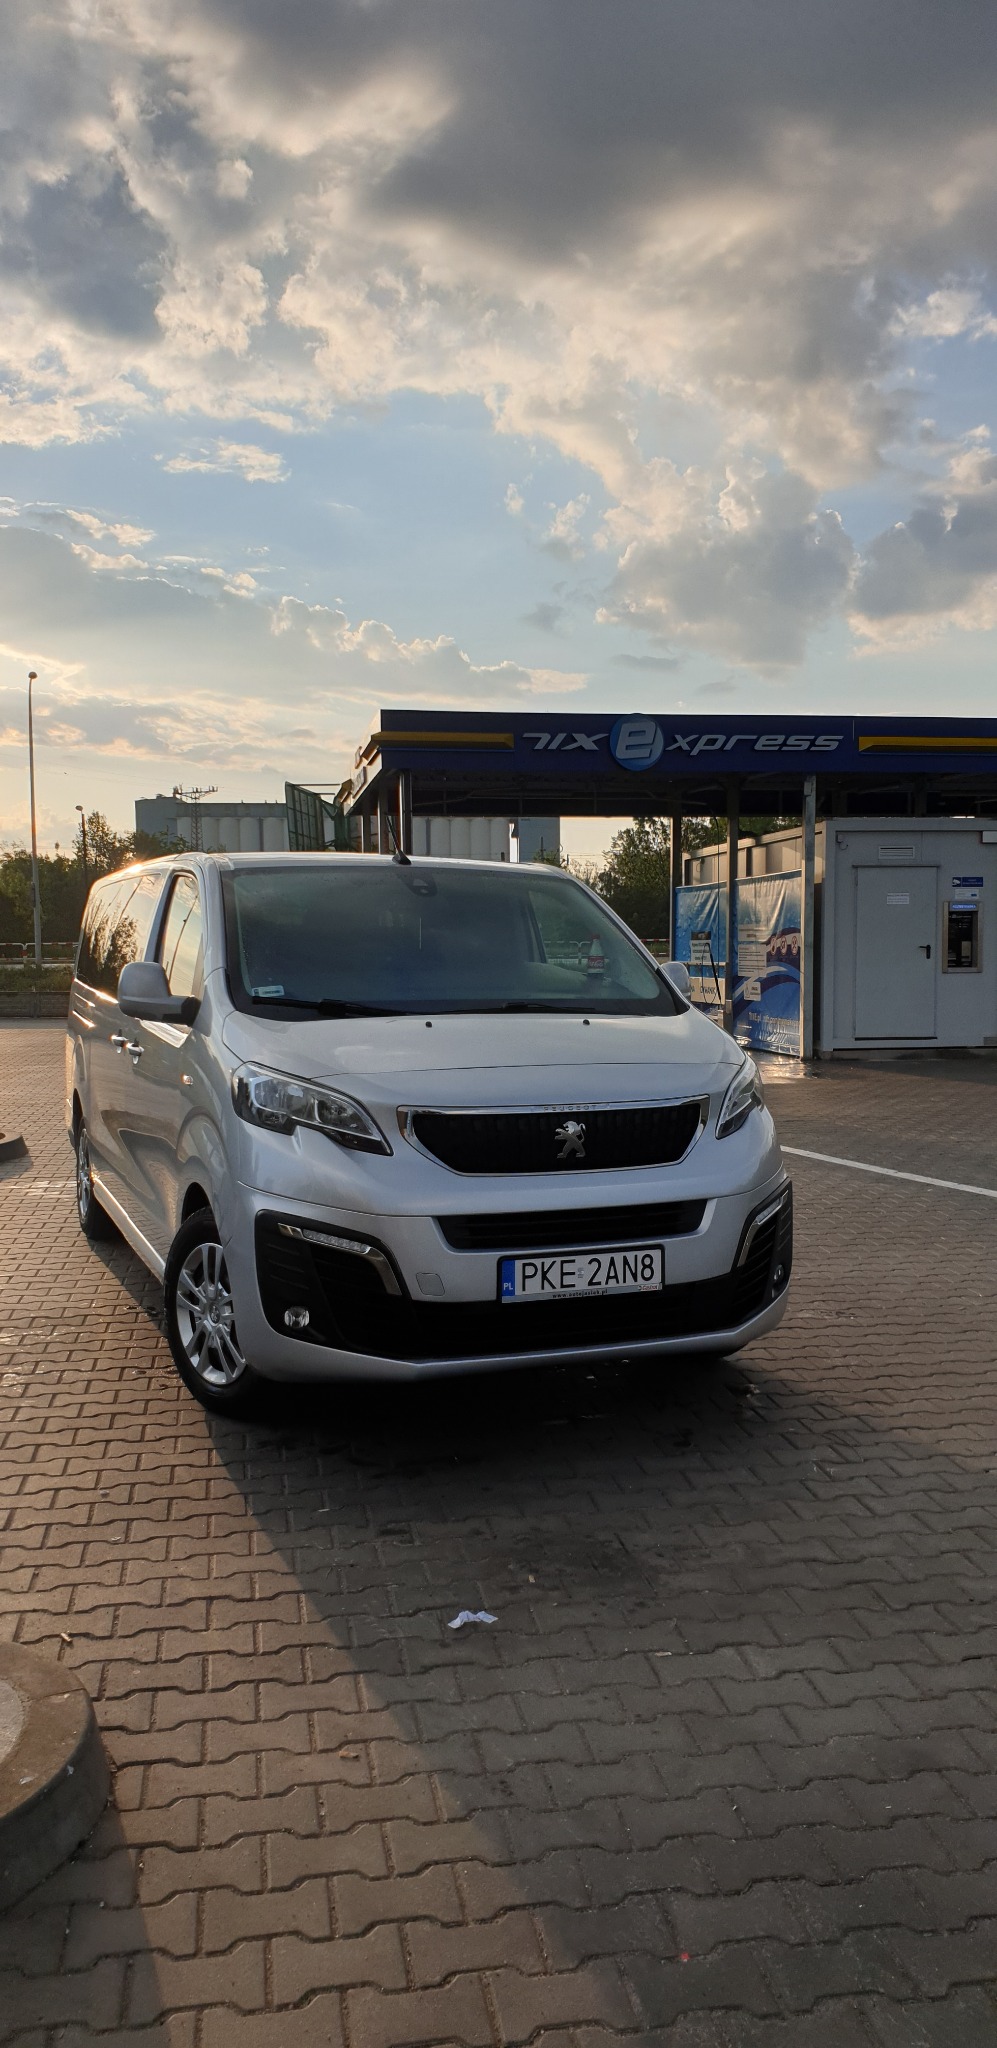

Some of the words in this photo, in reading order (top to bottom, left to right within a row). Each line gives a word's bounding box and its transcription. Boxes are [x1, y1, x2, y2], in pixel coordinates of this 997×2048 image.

[543, 1104, 597, 1112] PEUGEOT
[503, 1282, 514, 1291] PL
[521, 1258, 576, 1292] PKE
[587, 1253, 655, 1287] 2AN8
